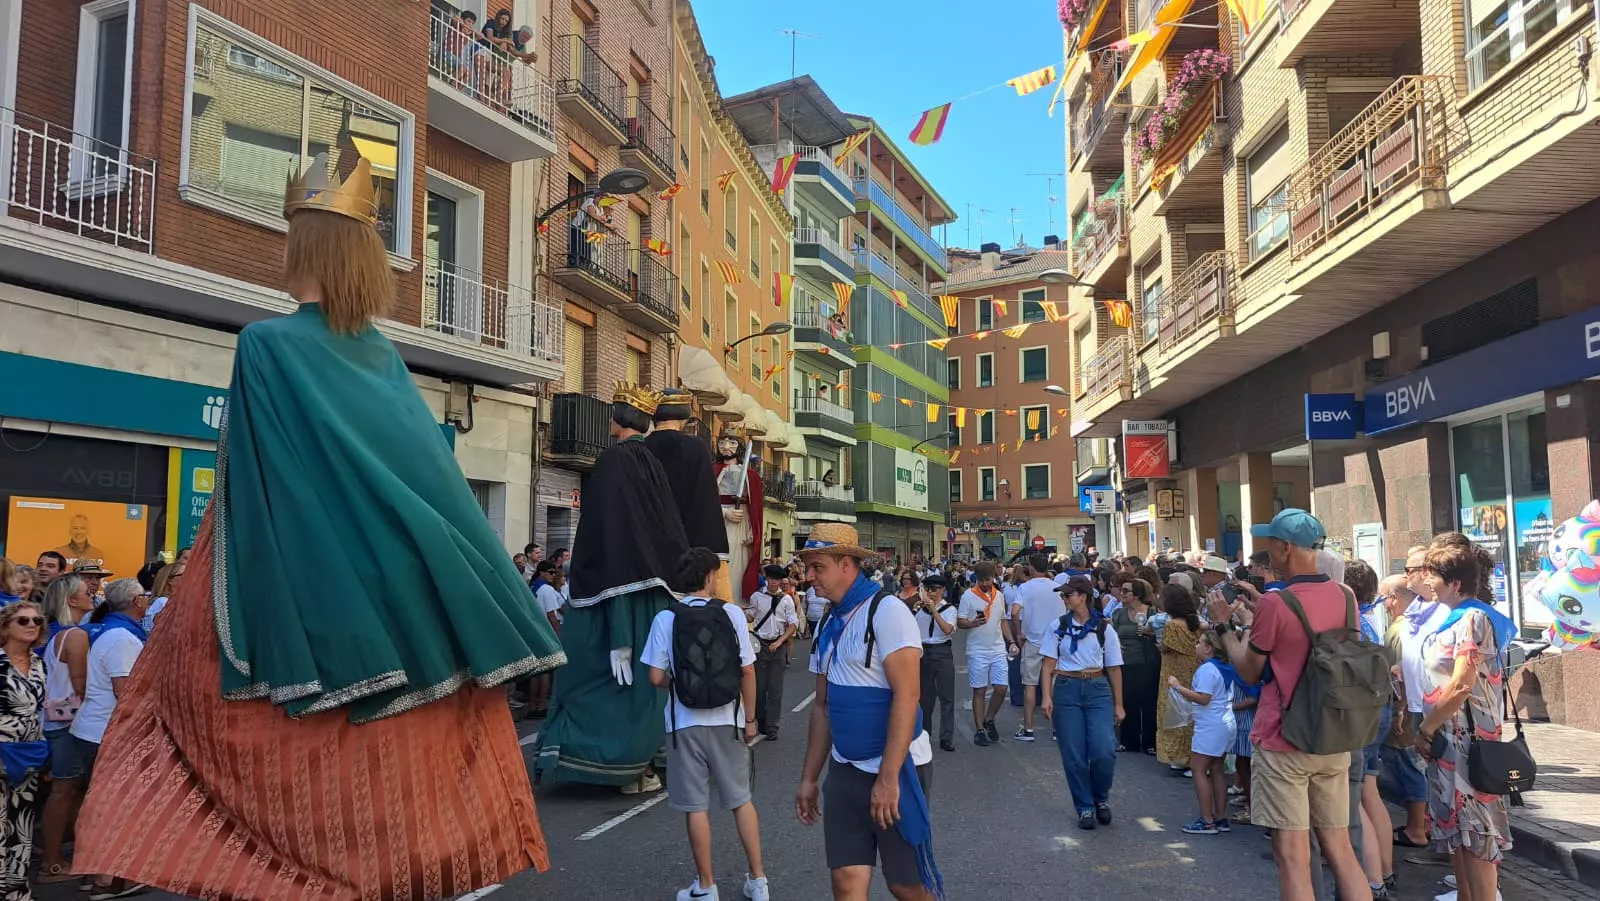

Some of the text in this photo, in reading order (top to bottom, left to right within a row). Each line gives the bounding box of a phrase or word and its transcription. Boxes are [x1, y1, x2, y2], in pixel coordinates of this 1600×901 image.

[1385, 376, 1436, 418] BBVA
[1312, 410, 1351, 422] BBVA
[1127, 423, 1140, 431] BAR
